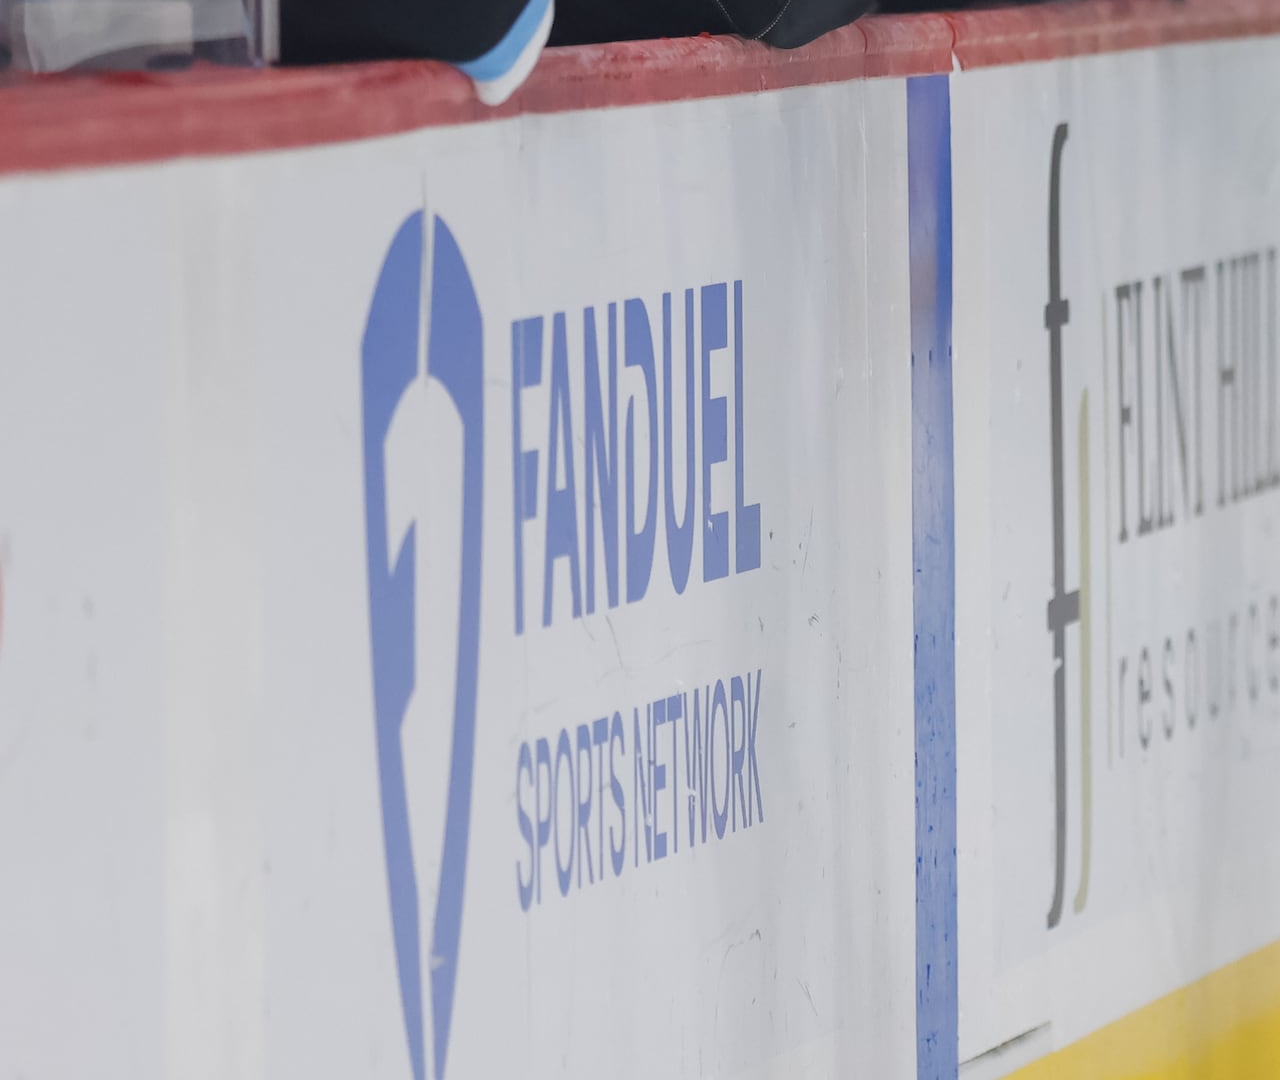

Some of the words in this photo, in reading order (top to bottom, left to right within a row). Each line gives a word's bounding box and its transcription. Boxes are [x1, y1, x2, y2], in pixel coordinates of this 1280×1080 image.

[511, 279, 762, 636] FANDUEL
[515, 711, 626, 913] SPORTS
[634, 669, 764, 867] NETWORK
